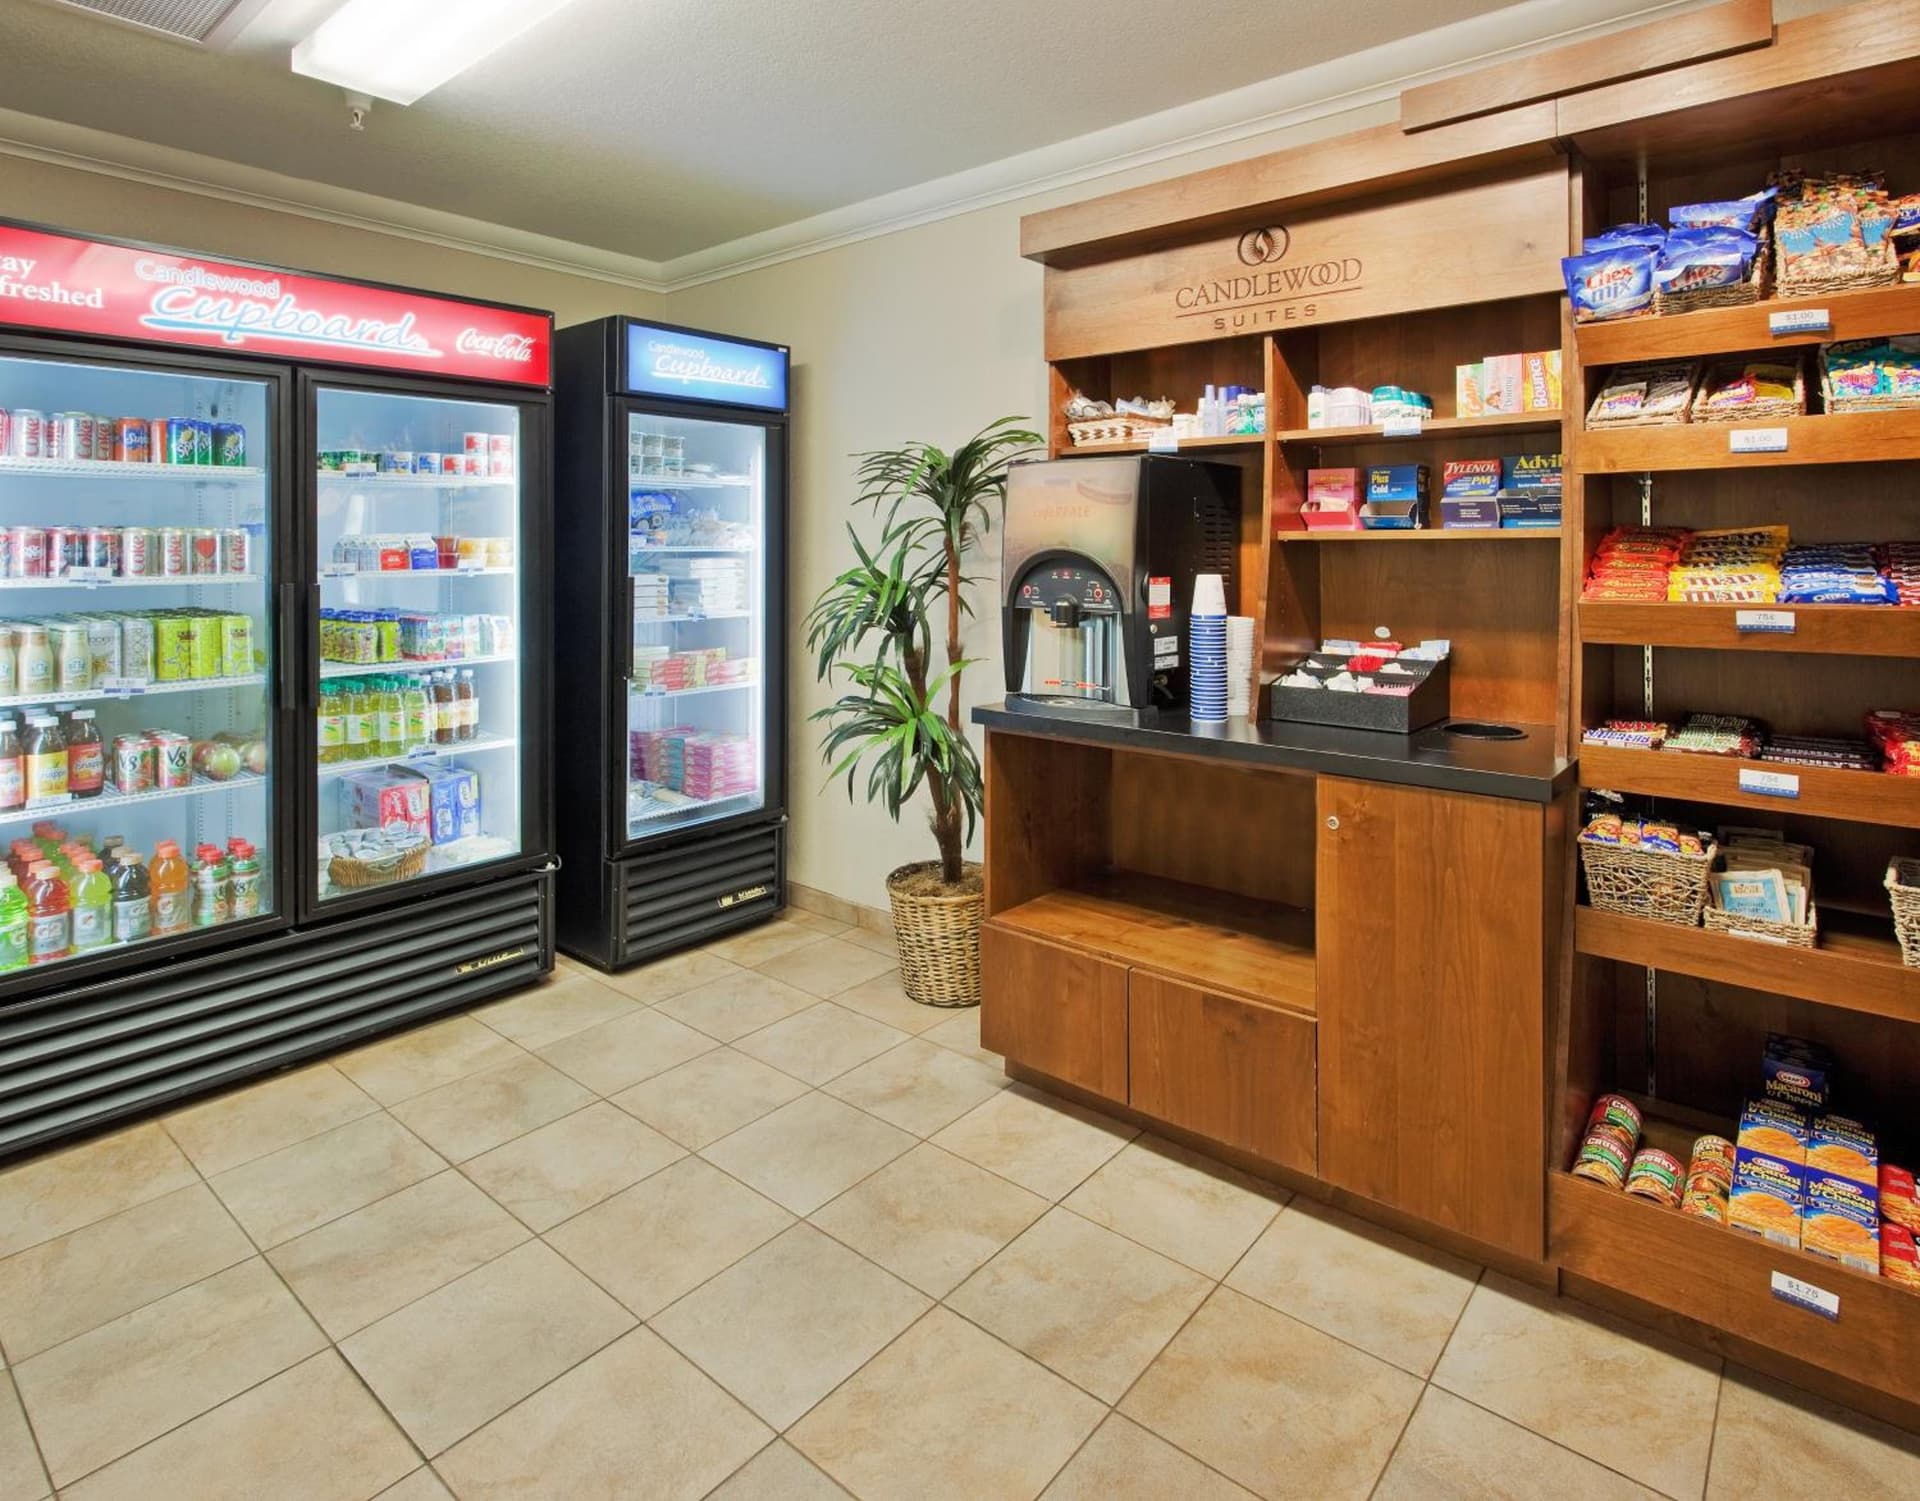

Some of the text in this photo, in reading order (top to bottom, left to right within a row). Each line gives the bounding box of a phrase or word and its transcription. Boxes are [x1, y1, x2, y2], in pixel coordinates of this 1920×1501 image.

[134, 257, 281, 299] Candlewood
[1175, 257, 1363, 309] CANDLEWOOD
[1586, 266, 1634, 290] Chex
[1591, 277, 1635, 303] mix
[150, 286, 427, 347] Cupboard
[1213, 303, 1318, 331] SUITES
[456, 327, 536, 362] Coca-Cola
[647, 340, 705, 359] Candlewood
[655, 354, 768, 386] Cupboard
[1445, 461, 1497, 475] TYLENOL
[1516, 454, 1561, 470] Advil
[1472, 476, 1491, 486] PM
[1586, 728, 1650, 746] SNICKERS
[119, 754, 138, 773] V8
[167, 746, 187, 768] V8
[1766, 1080, 1823, 1103] Macaroni
[1587, 1137, 1627, 1163] CHUNKY
[1635, 1154, 1676, 1172] CHUNKY
[1739, 1162, 1801, 1186] Macaroni
[1750, 1168, 1800, 1191] Cheese
[1808, 1181, 1877, 1208] Macaroni
[1822, 1190, 1876, 1213] Cheese
[1787, 1280, 1818, 1299] $1.75
